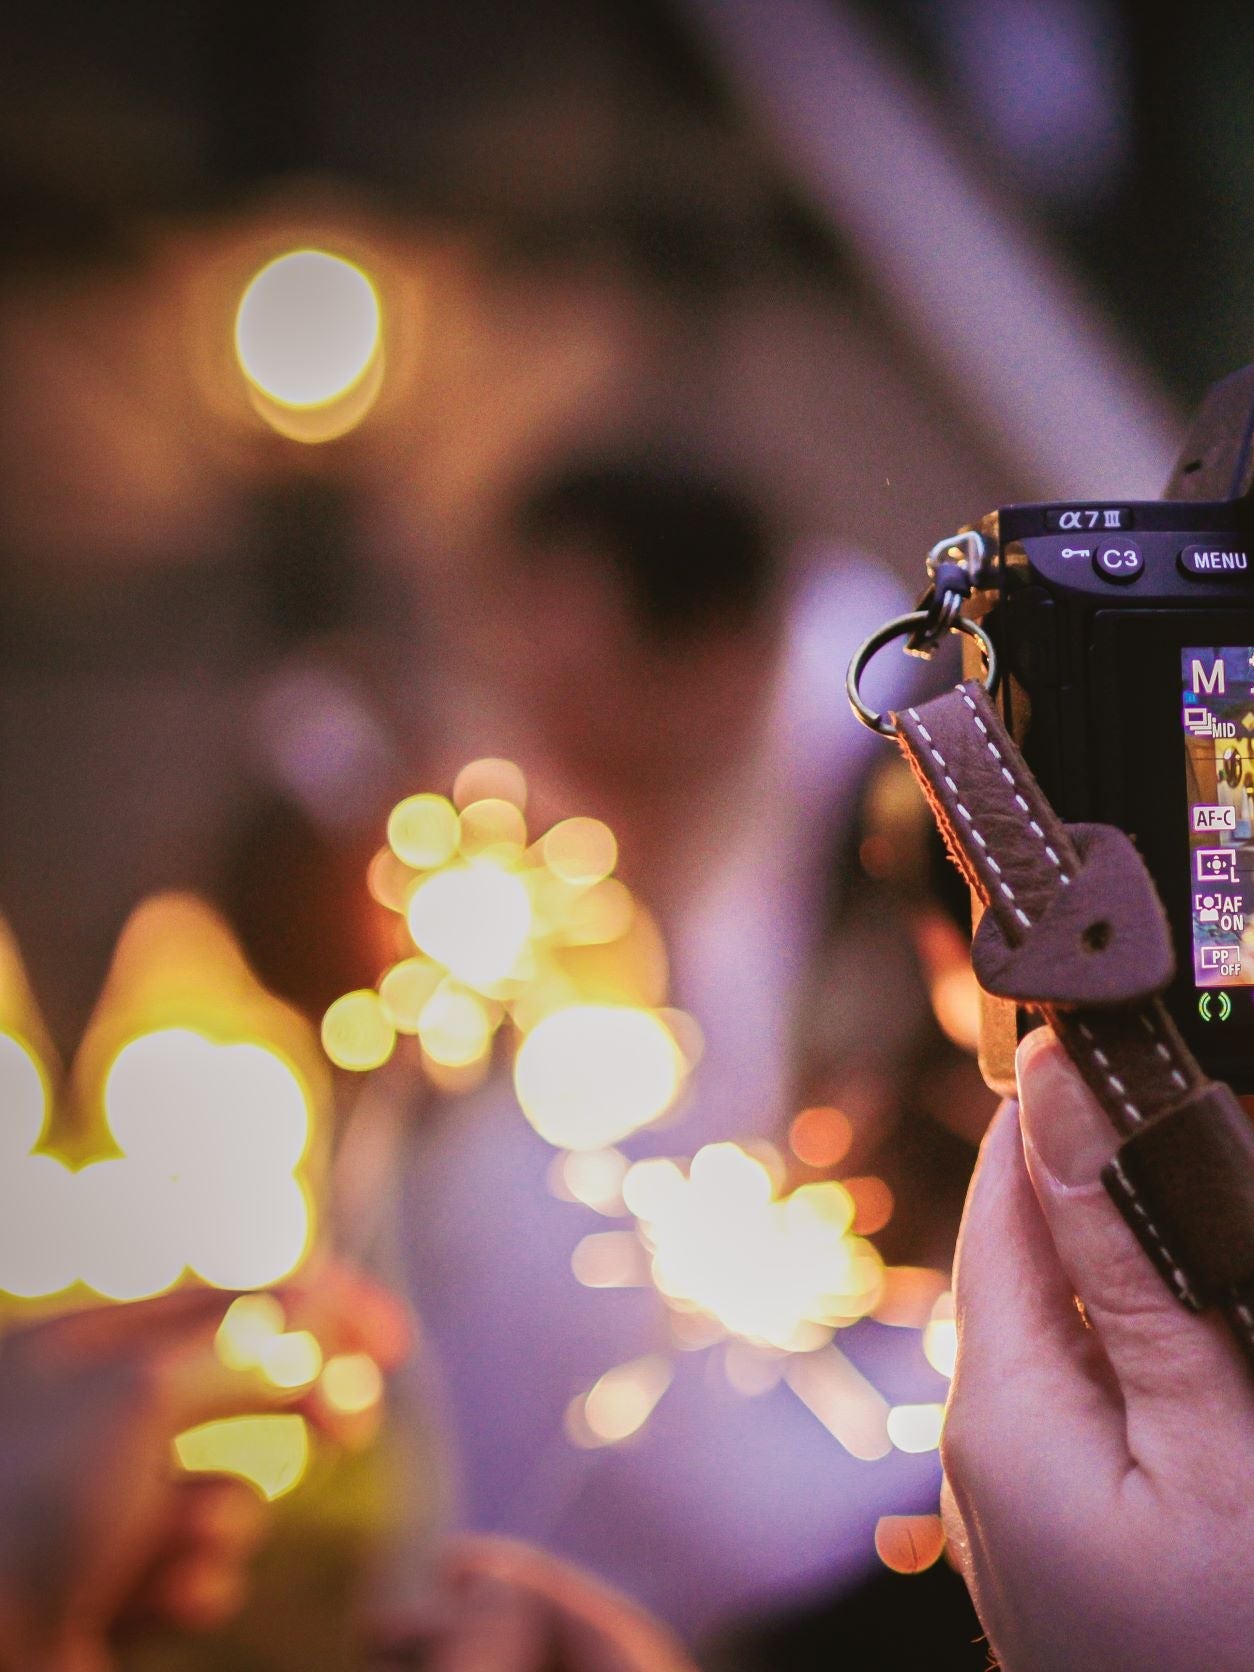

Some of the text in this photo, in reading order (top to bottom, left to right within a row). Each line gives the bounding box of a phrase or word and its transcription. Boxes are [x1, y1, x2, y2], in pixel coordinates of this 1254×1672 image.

[1103, 549, 1138, 568] C3
[1194, 551, 1248, 570] MENU
[1191, 659, 1226, 694] M
[1196, 810, 1232, 827] AF-C
[1222, 896, 1243, 913] AF
[1220, 915, 1244, 931] ON
[1212, 950, 1229, 964] PP
[1220, 964, 1242, 976] OFF
